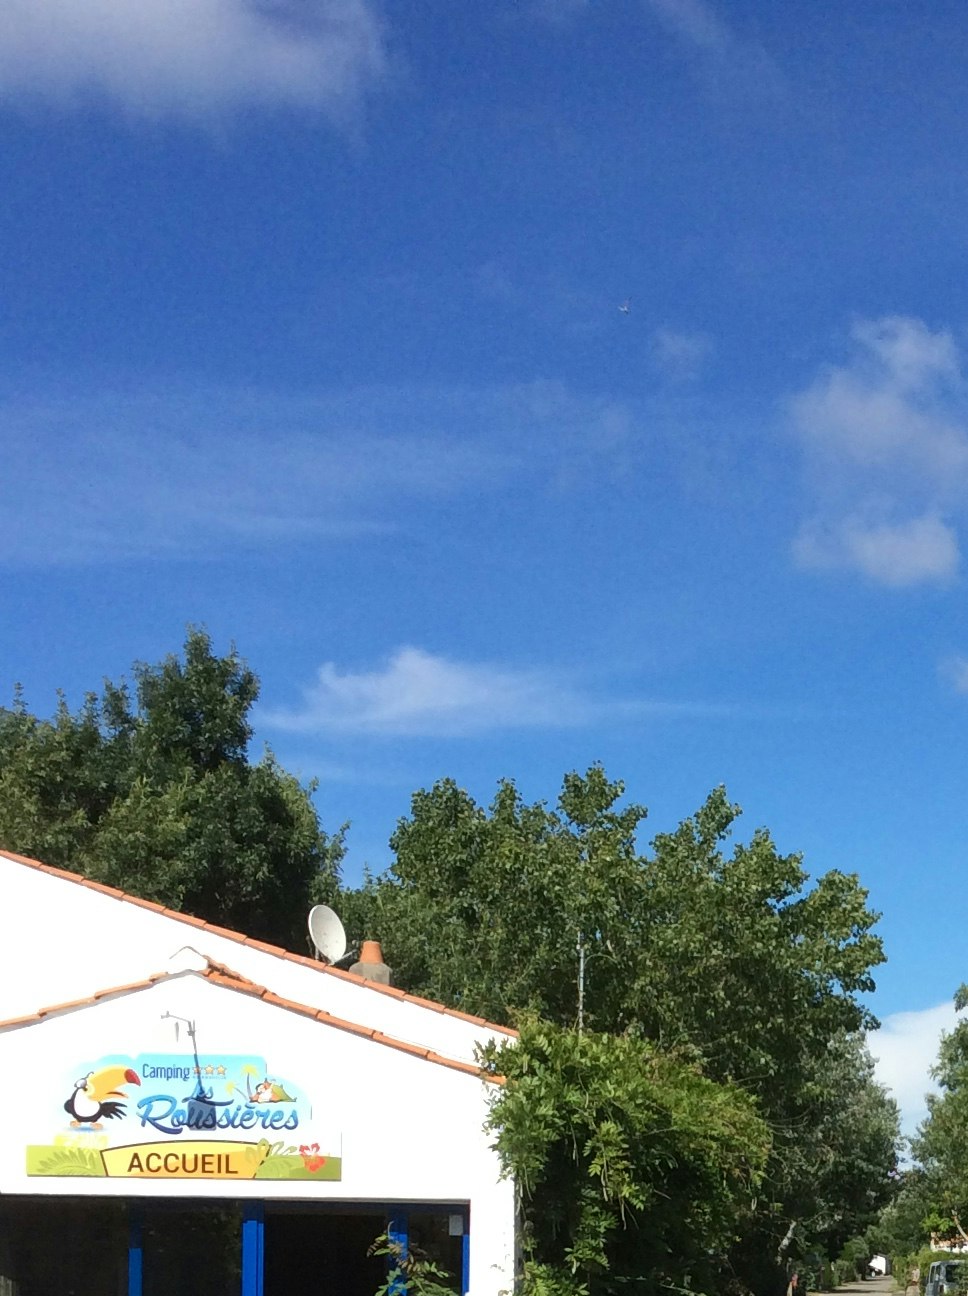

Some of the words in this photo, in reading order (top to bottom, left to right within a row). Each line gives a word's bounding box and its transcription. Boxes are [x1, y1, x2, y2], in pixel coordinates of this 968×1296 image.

[142, 1063, 190, 1081] Camping
[136, 1095, 299, 1135] Roussières
[127, 1152, 238, 1174] ACCUEIL
